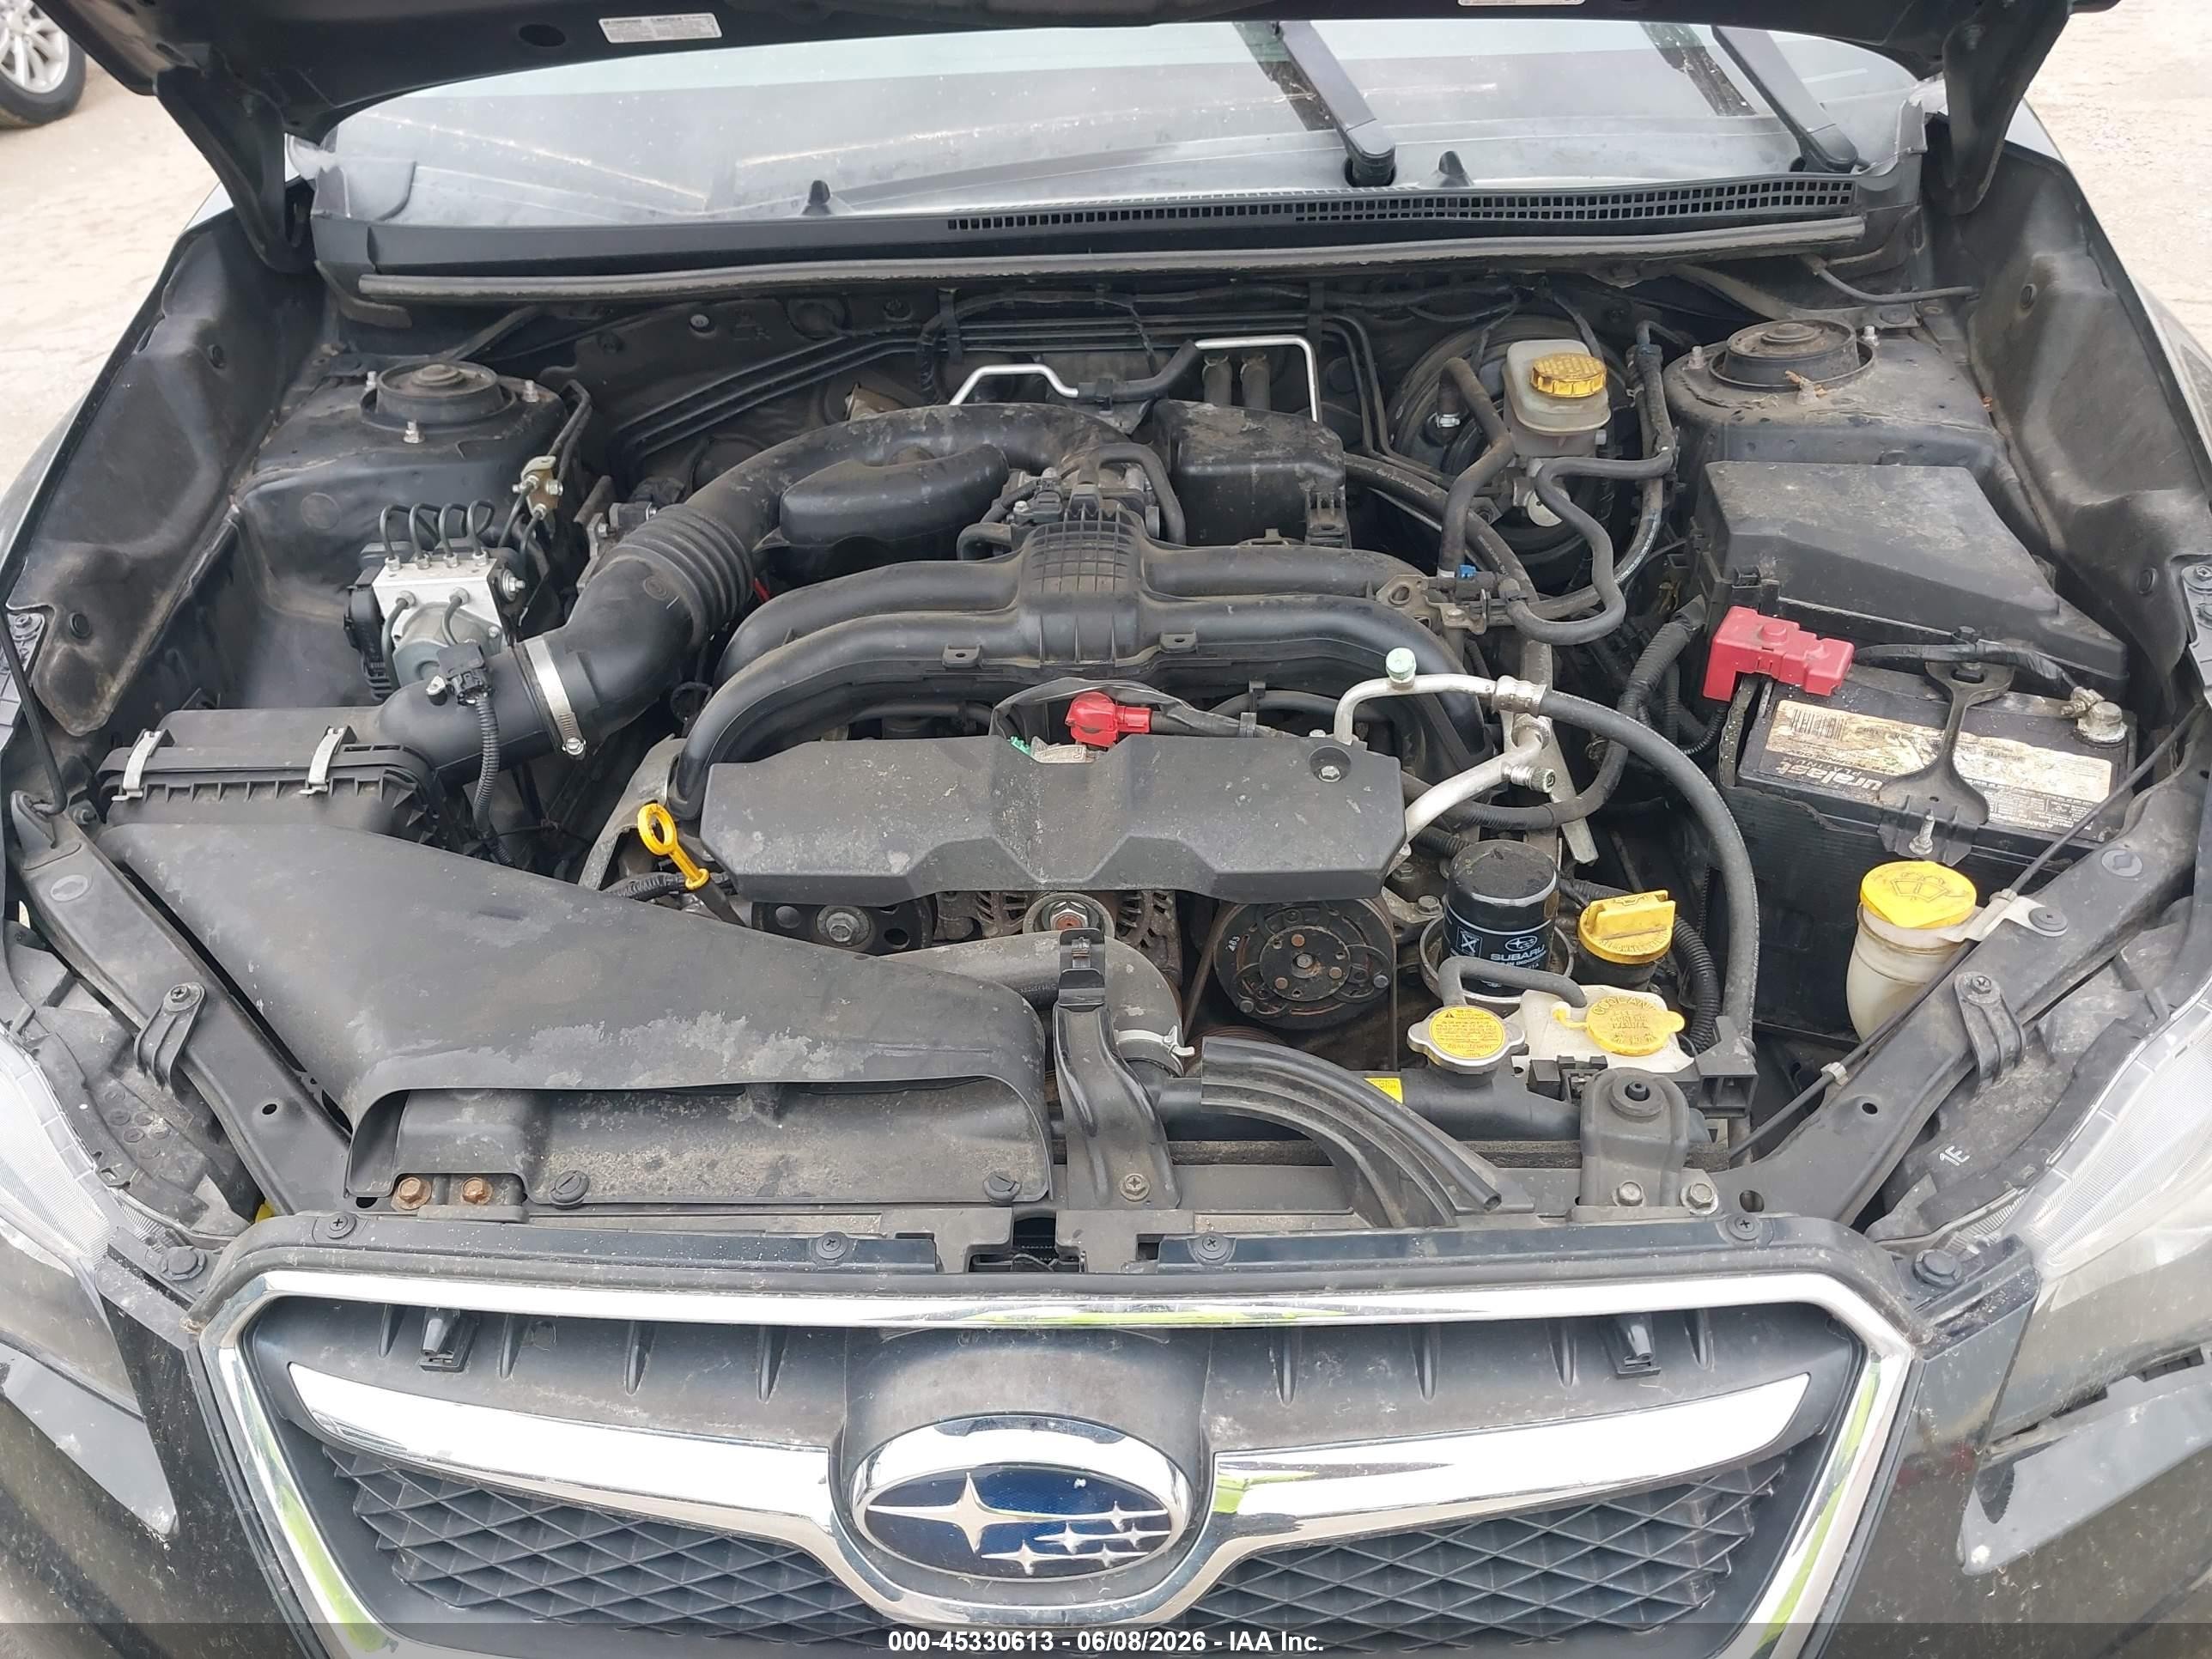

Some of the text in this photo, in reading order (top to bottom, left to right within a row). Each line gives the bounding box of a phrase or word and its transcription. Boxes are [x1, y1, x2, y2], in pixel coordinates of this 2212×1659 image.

[1775, 760, 1883, 791] uralast
[1783, 756, 1863, 776] PLATINUM
[1490, 944, 1545, 962] SUBARU
[1592, 996, 1656, 1015] COOLANT
[1939, 1146, 1971, 1166] 1E
